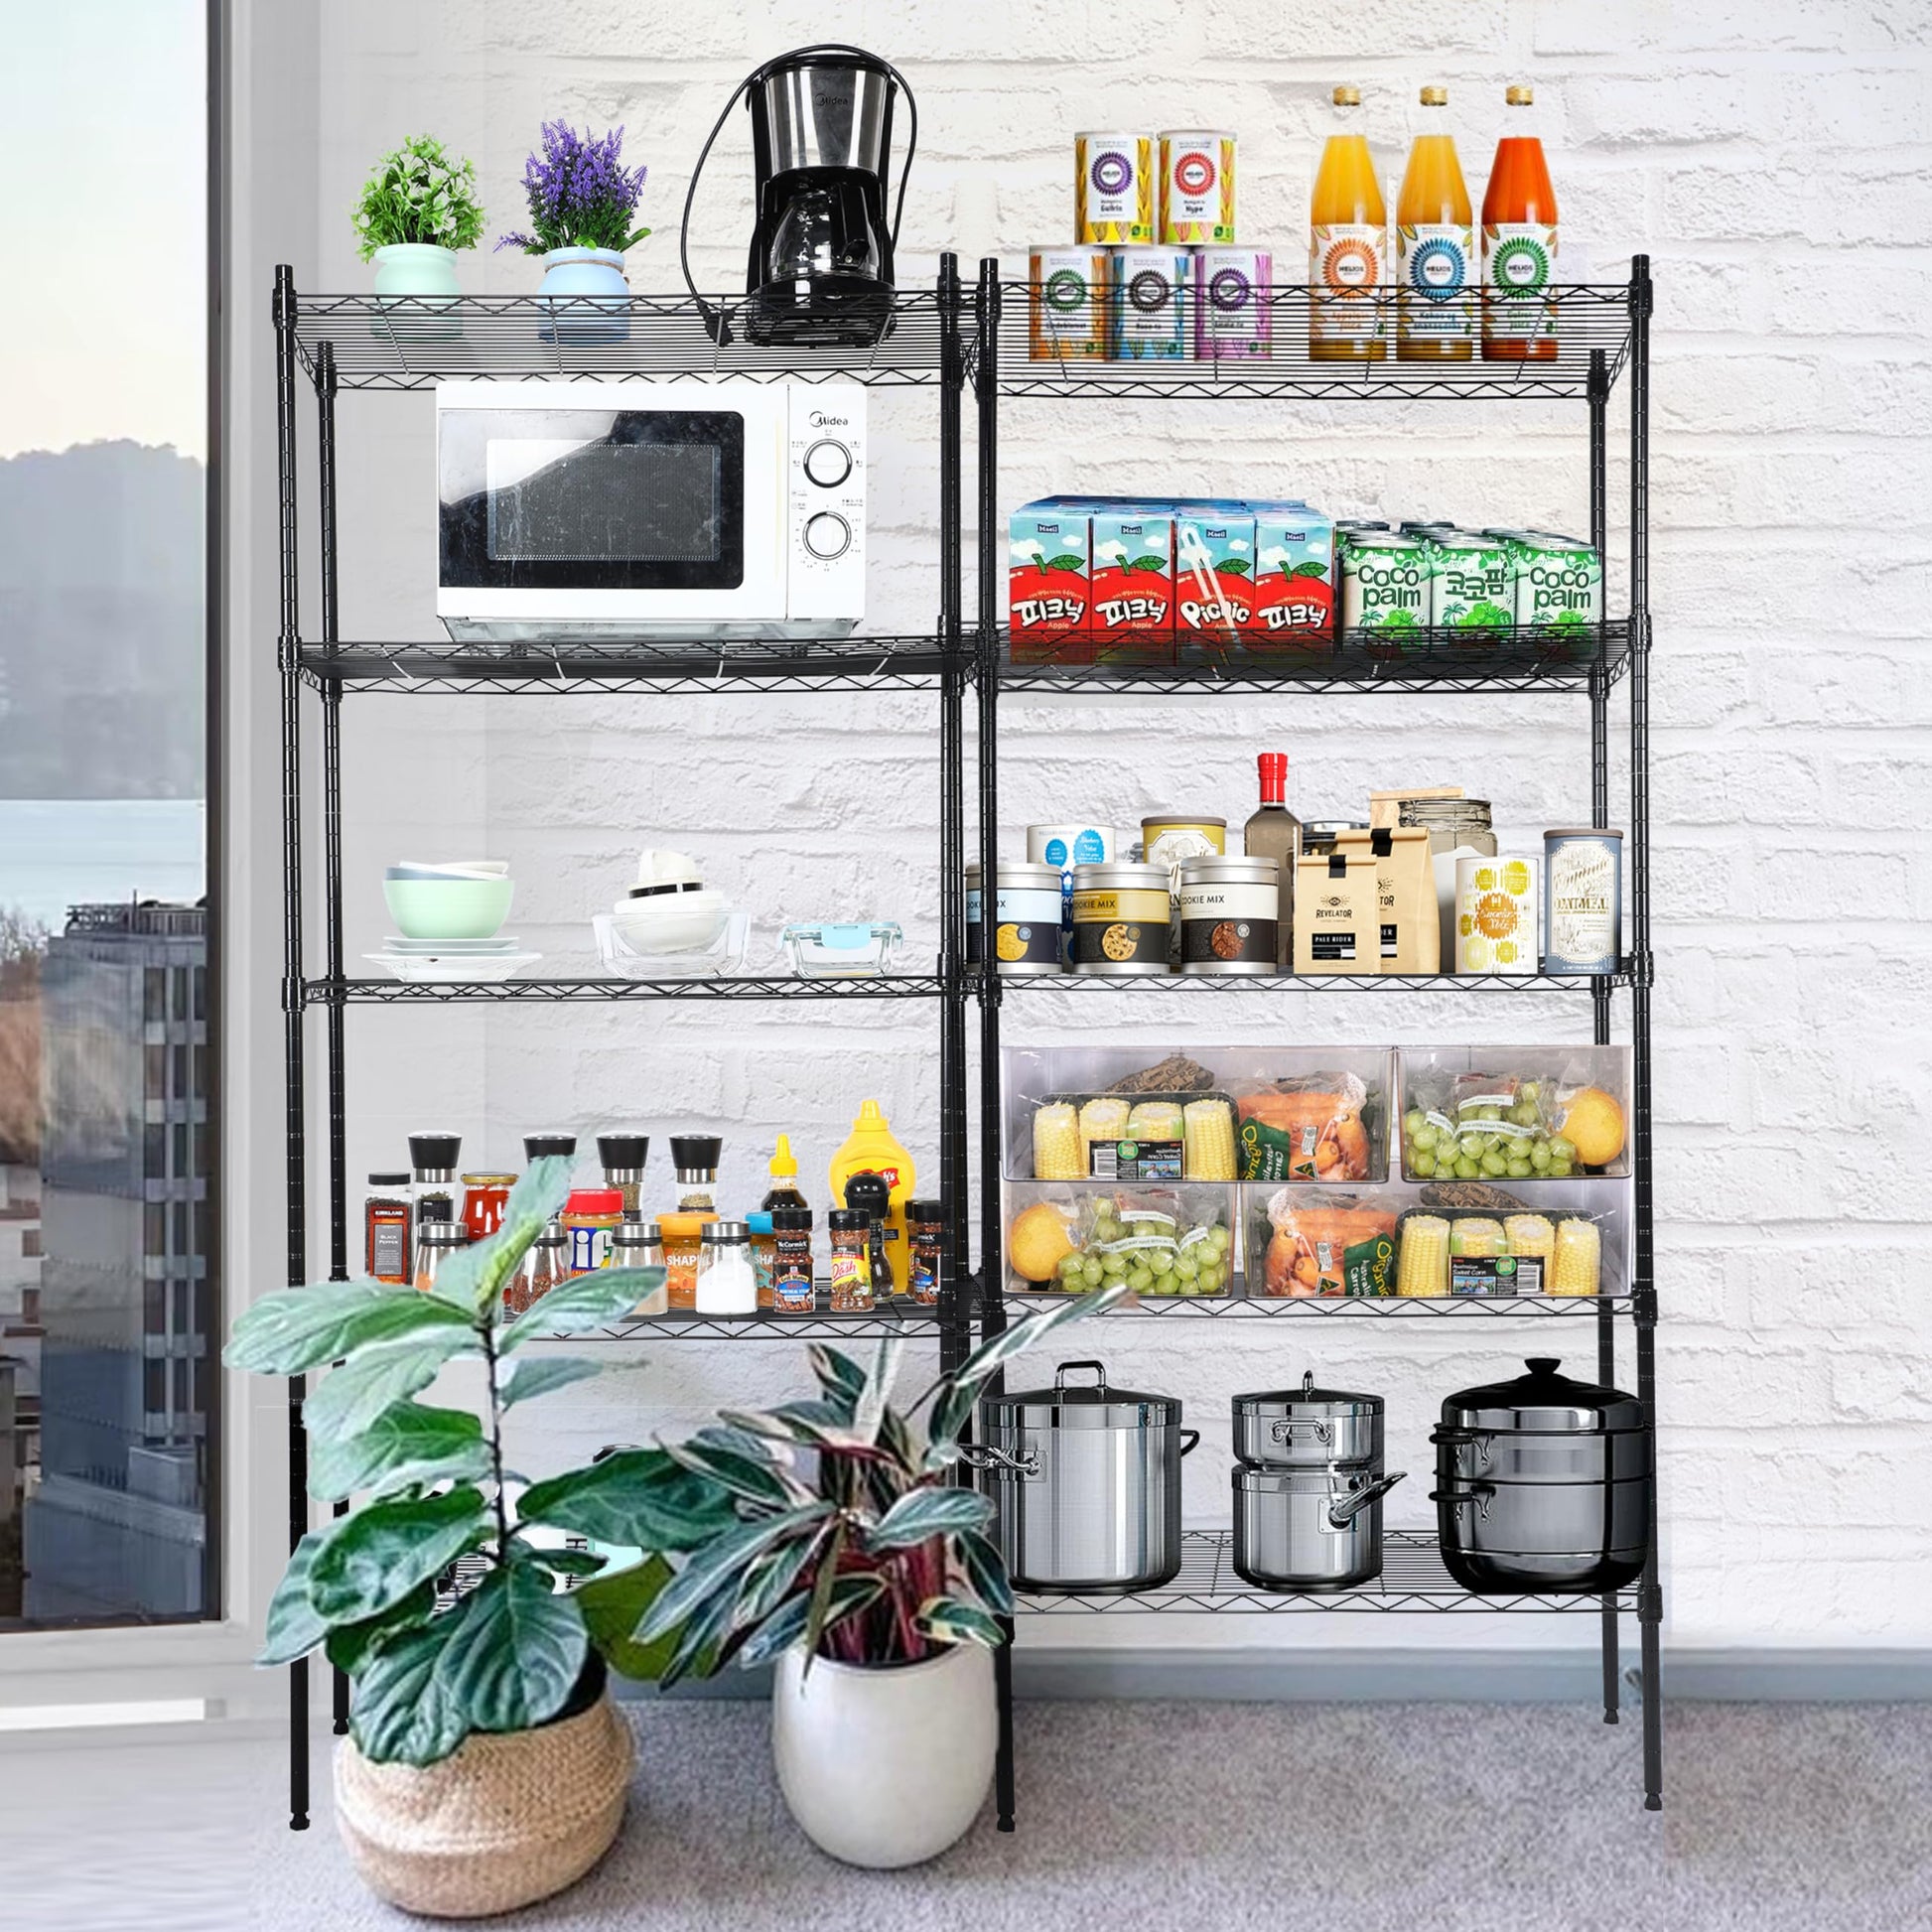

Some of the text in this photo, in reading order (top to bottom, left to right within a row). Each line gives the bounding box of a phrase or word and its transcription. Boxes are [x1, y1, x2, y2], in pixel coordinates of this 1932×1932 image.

[815, 92, 848, 106] Midea
[809, 410, 848, 428] Midea
[1446, 568, 1507, 601] 코코팜
[1363, 587, 1421, 610] palm
[1534, 589, 1590, 611] palm
[1011, 598, 1085, 627] 피크닉
[1095, 598, 1168, 627] 피크닉
[1258, 604, 1327, 631] 피크닉
[1097, 899, 1116, 908] MIX
[1315, 908, 1353, 918] REVELATOR
